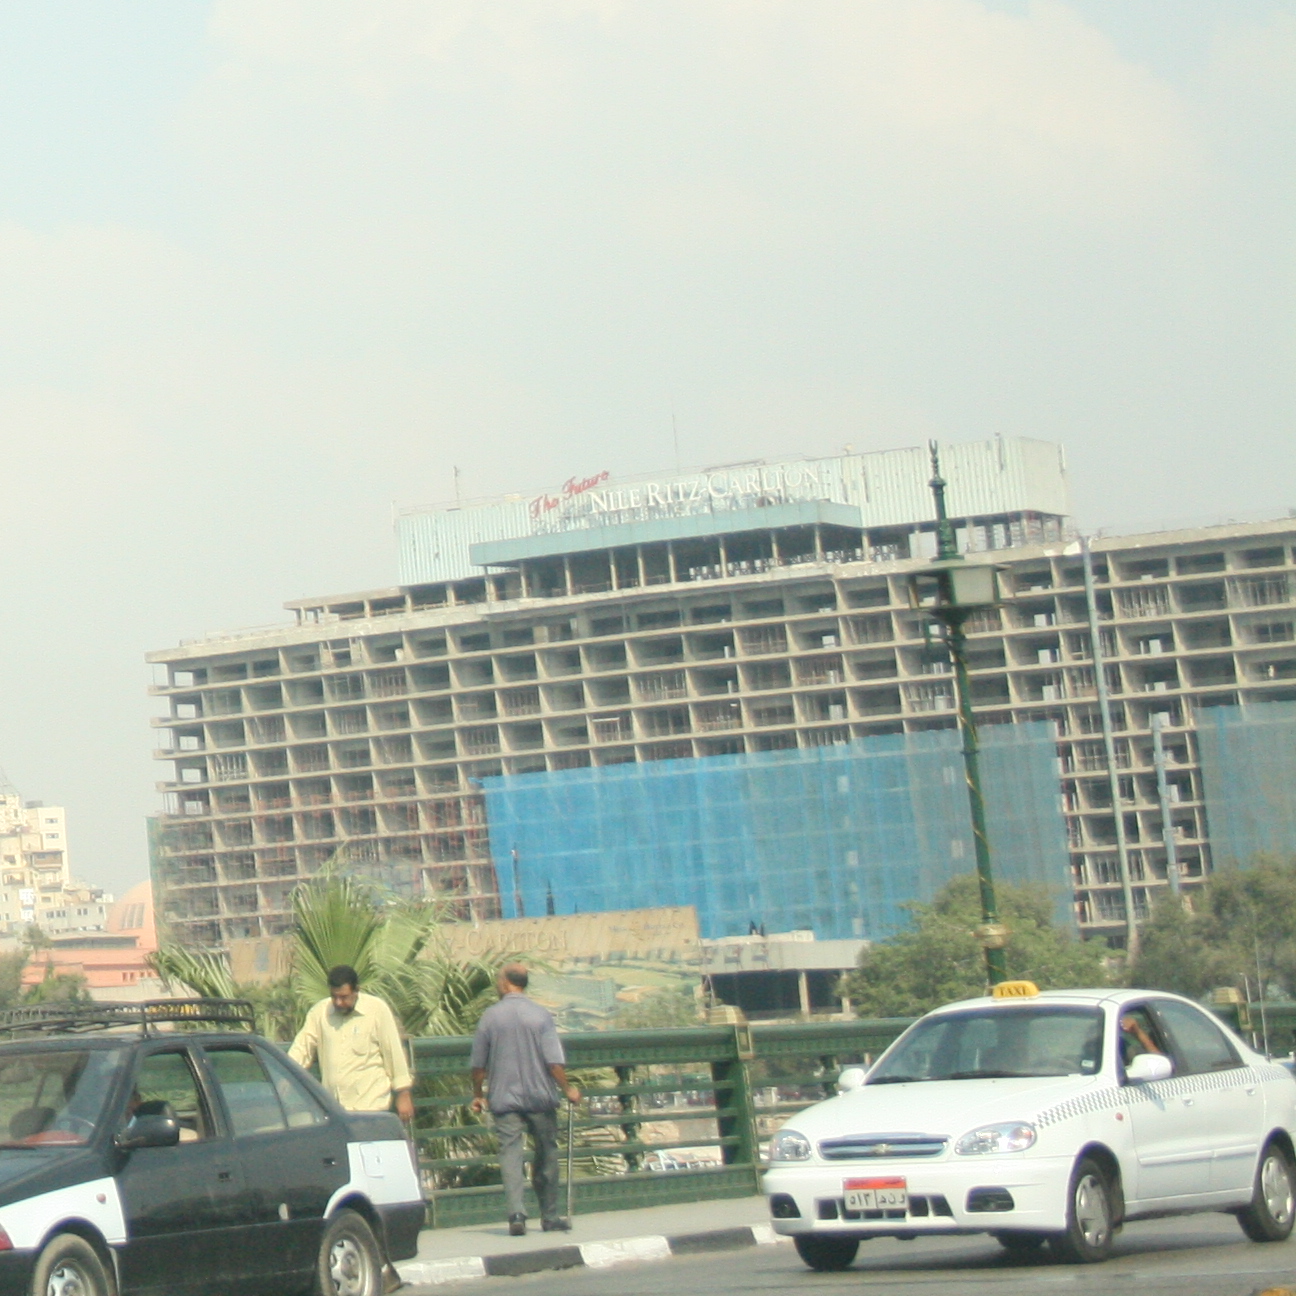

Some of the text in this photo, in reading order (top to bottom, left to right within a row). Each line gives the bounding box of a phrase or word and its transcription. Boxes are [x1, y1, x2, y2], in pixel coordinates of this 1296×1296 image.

[529, 469, 610, 520] The Future
[588, 487, 641, 514] NILE
[999, 985, 1027, 997] TAXI
